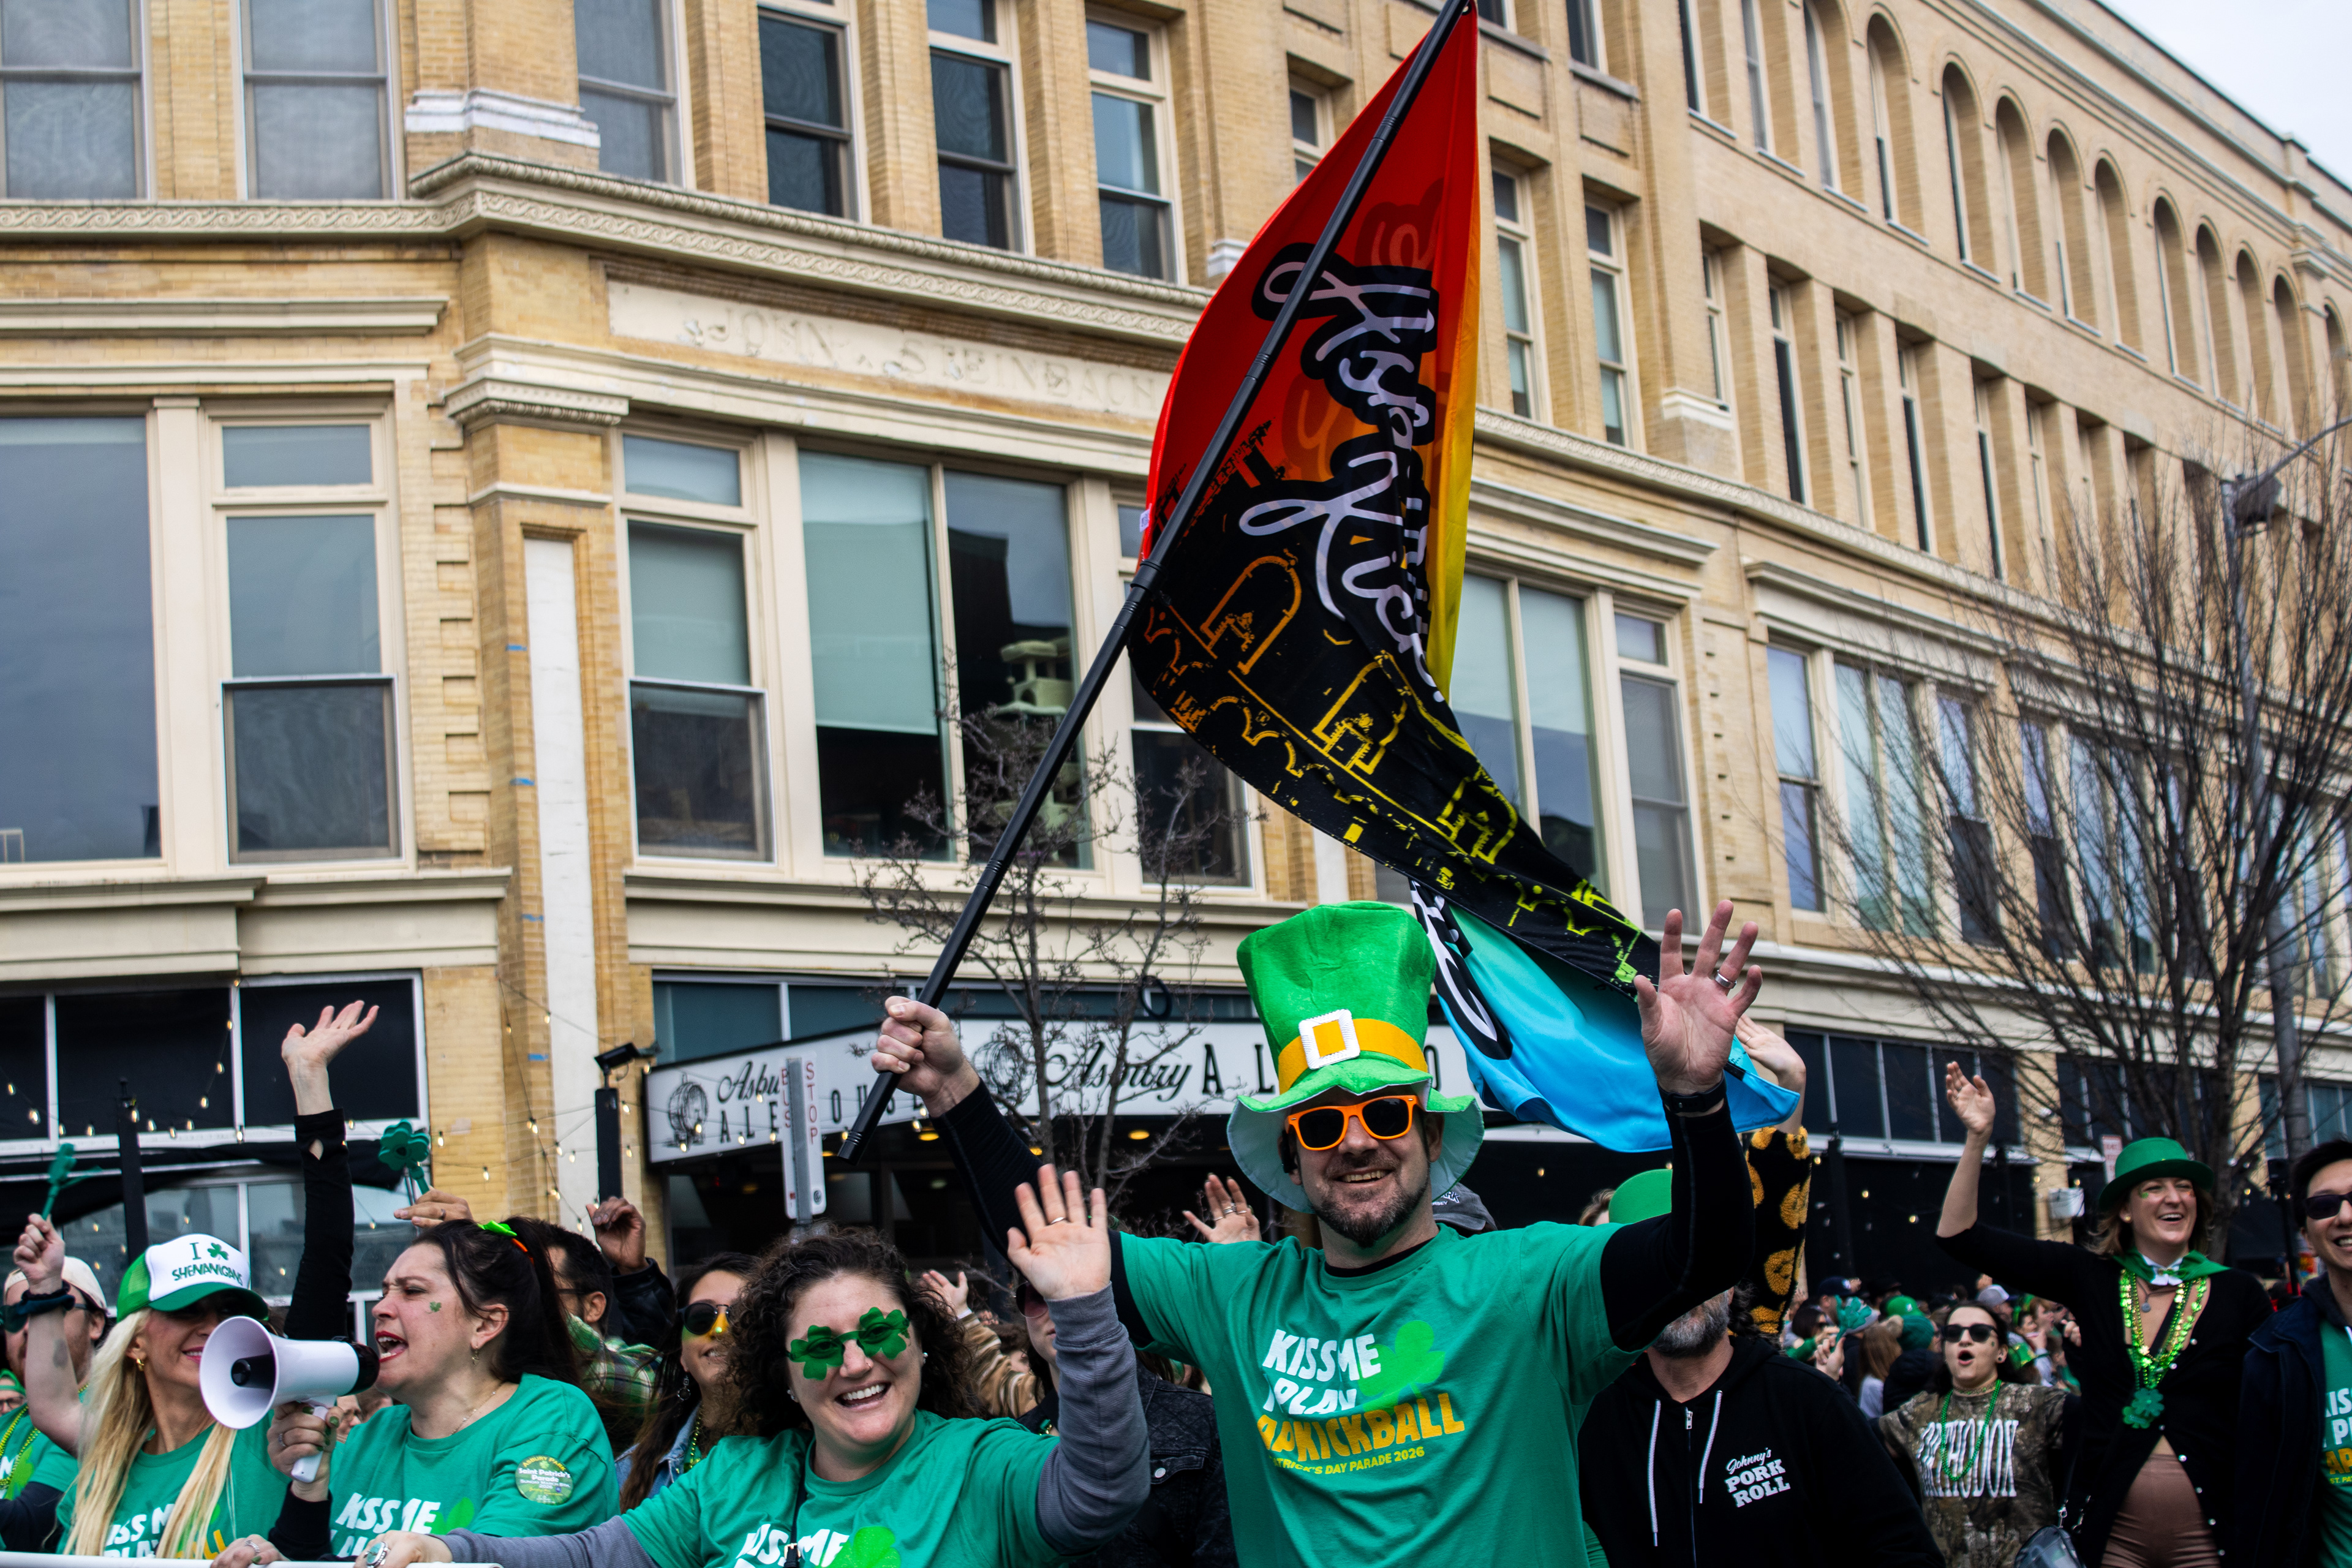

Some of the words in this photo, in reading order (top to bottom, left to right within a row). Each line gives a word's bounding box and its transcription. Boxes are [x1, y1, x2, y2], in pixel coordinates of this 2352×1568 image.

[1202, 1043, 1276, 1095] AL
[806, 1061, 818, 1145] STOP
[189, 1242, 202, 1261] I
[172, 1262, 243, 1287] SHENANIGANS
[1262, 1329, 1338, 1382] KISS
[1338, 1333, 1382, 1381] ME
[1294, 1392, 1465, 1462] KICKBALL
[548, 1457, 567, 1471] PARK
[1269, 1456, 1324, 1474] ATRICK'S
[1325, 1463, 1348, 1474] DAY
[1349, 1452, 1393, 1472] PARADE
[1393, 1446, 1425, 1462] 2026
[1726, 1447, 1772, 1475] Johnny's
[531, 1474, 560, 1483] Parade
[1724, 1458, 1787, 1494] PORK
[1732, 1476, 1792, 1508] ROLL
